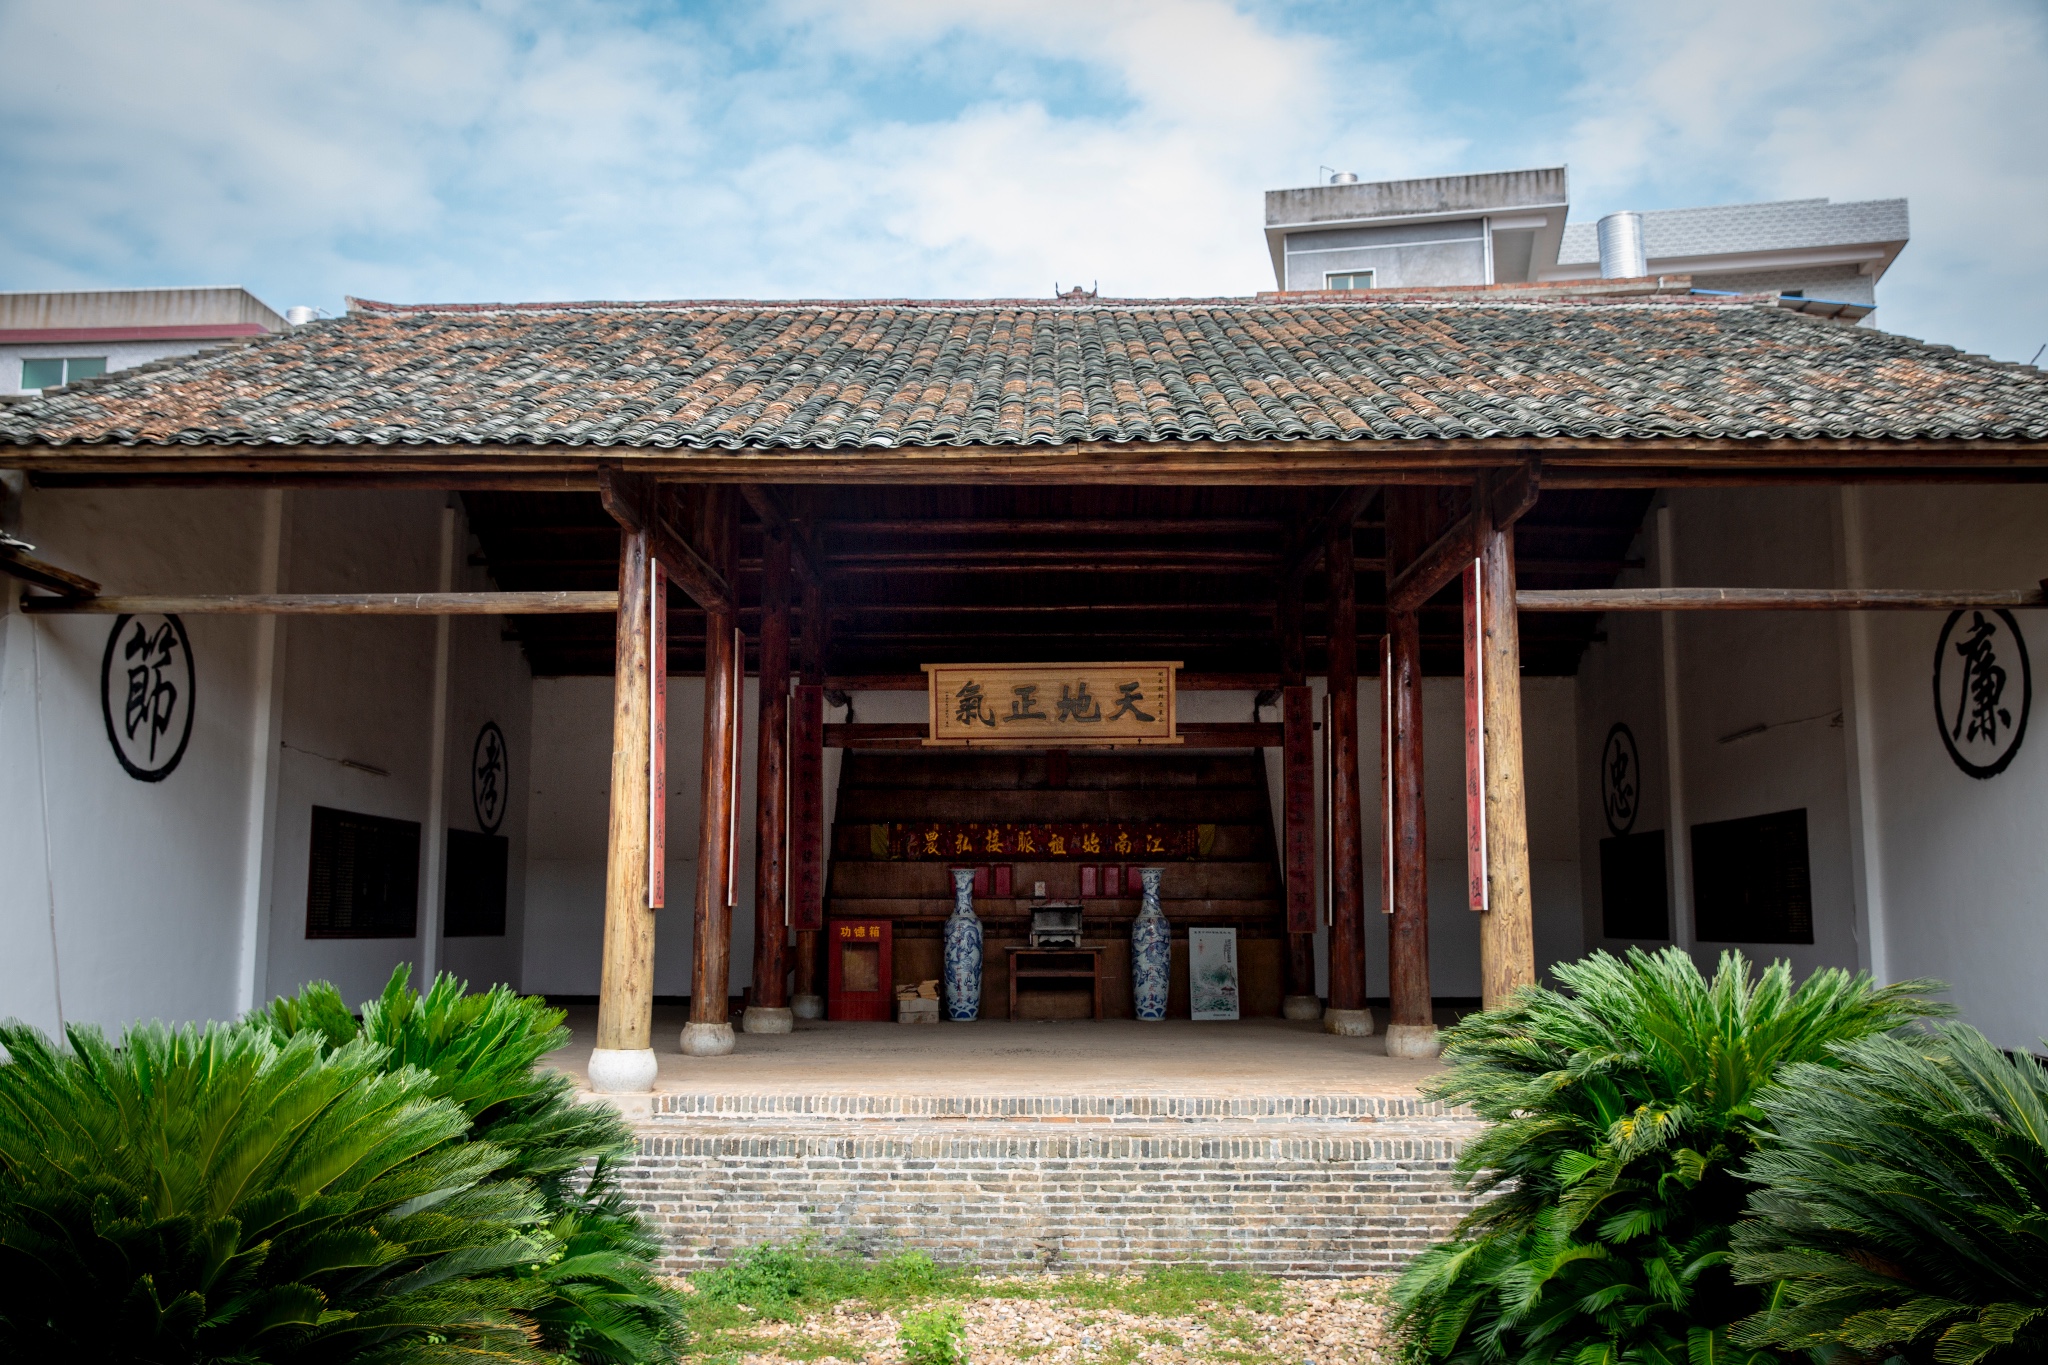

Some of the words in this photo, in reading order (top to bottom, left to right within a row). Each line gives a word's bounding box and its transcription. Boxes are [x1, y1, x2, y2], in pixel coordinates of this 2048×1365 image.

[125, 621, 177, 763] 節
[1953, 611, 2011, 746] 廉
[478, 733, 502, 819] 孝
[1610, 738, 1633, 818] 忠
[840, 926, 880, 938] 功德箱
